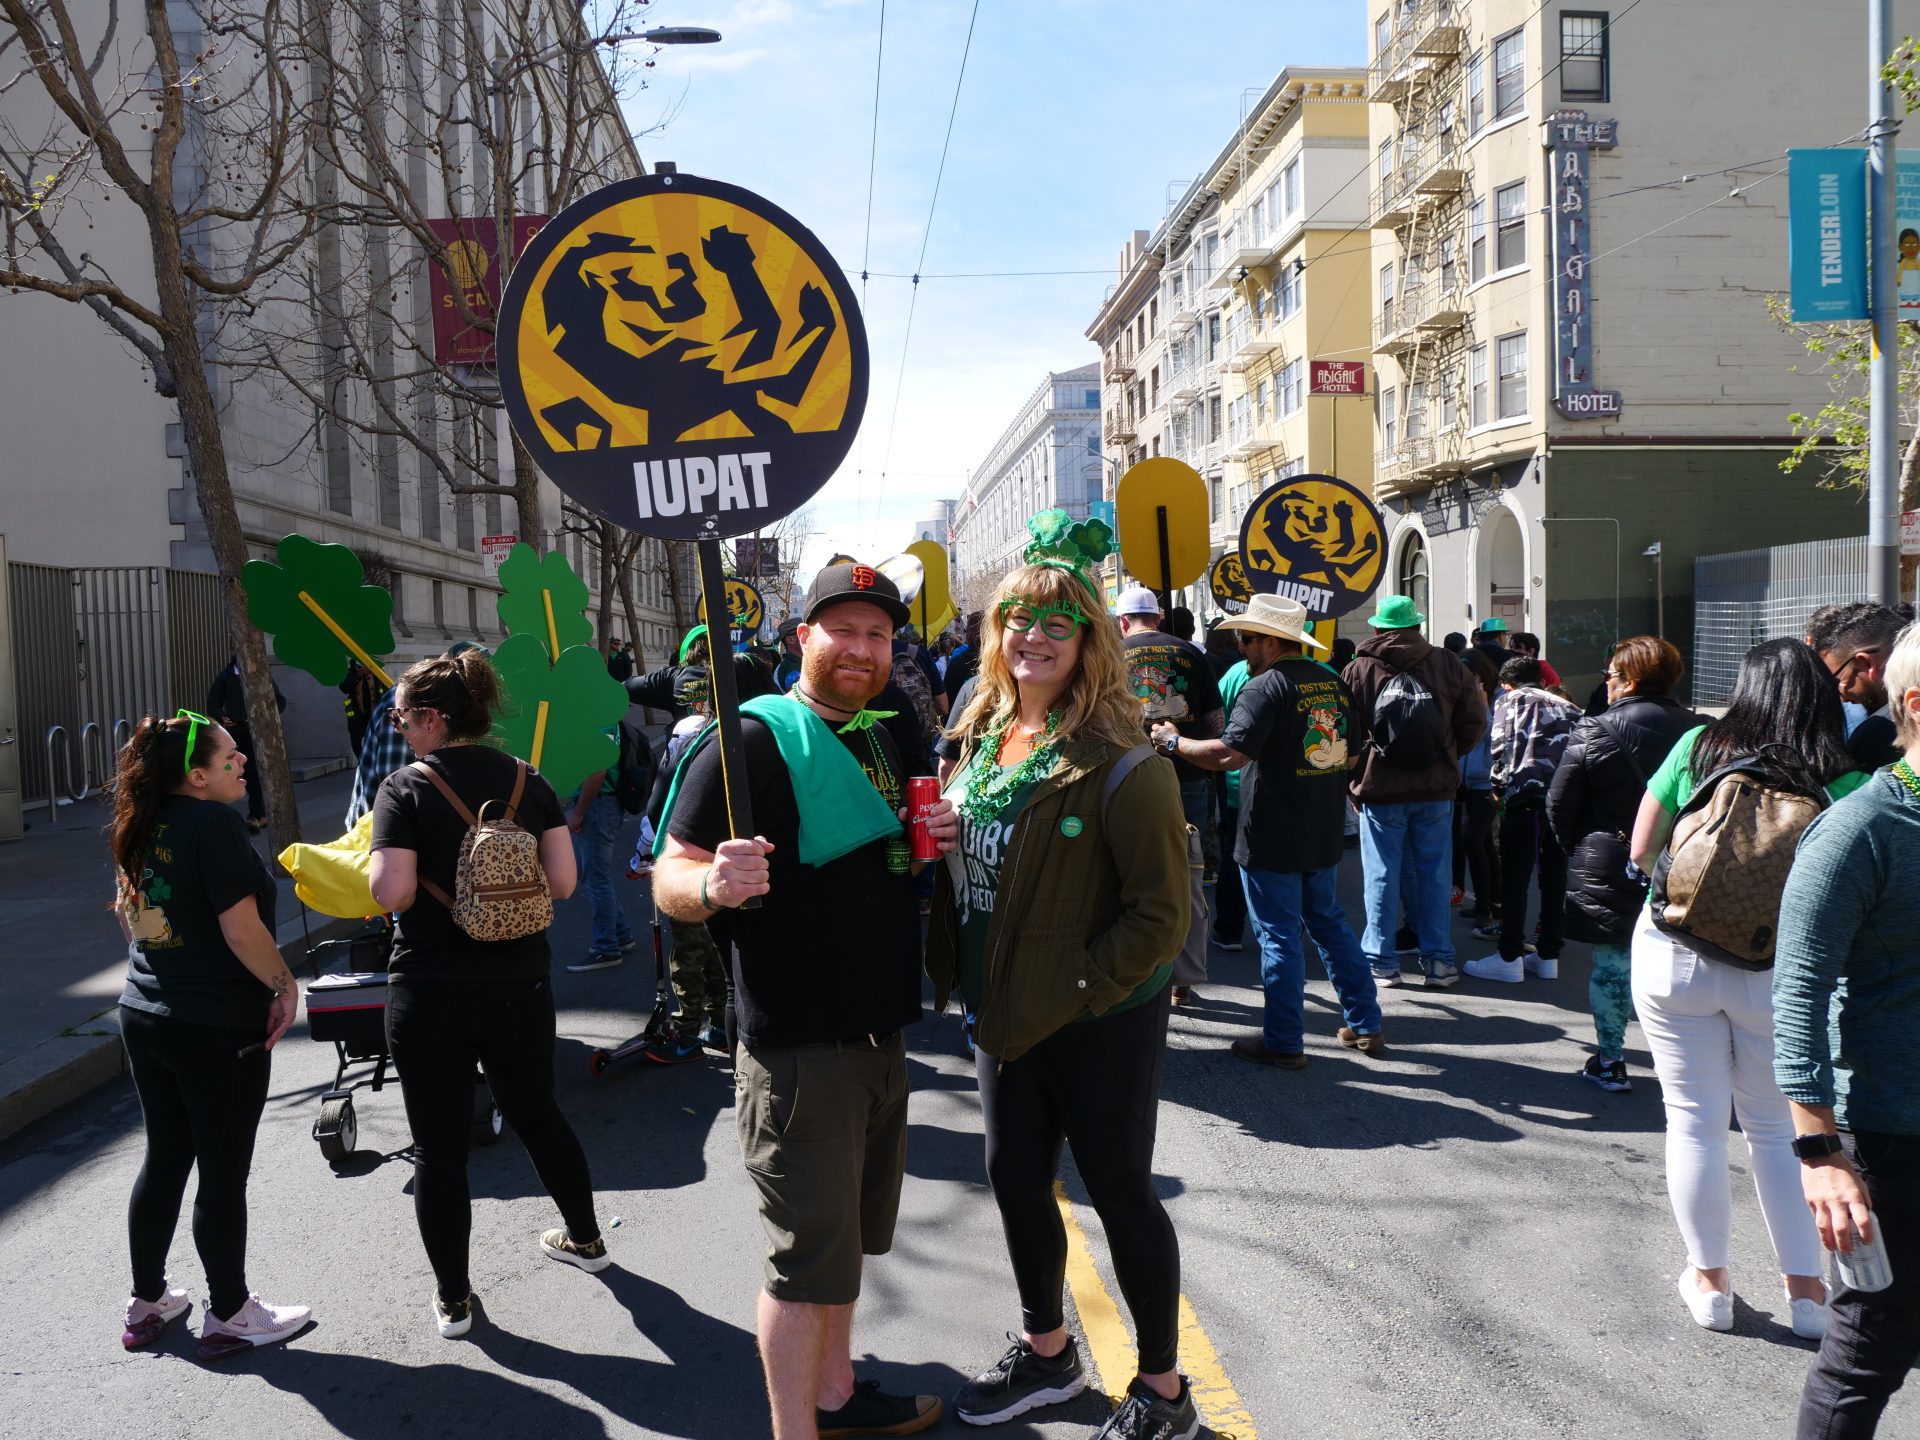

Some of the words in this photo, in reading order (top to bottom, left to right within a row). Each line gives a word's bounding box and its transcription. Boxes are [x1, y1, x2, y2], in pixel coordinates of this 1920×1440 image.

[1556, 122, 1612, 143] THE
[1818, 173, 1843, 287] TENDERLOIN
[1562, 151, 1587, 384] ABIGAIL
[443, 291, 492, 308] SCM
[1327, 362, 1345, 370] THE
[1317, 369, 1358, 384] ABIGAIL
[1322, 384, 1352, 392] HOTEL
[1567, 394, 1618, 412] HOTEL
[633, 451, 772, 518] IUPAT
[482, 544, 493, 554] NO
[1124, 645, 1179, 658] DISTRICT
[1127, 655, 1168, 667] OUNCIL
[1299, 681, 1340, 693] DISTRICT
[1297, 694, 1337, 713] COUNCIL
[966, 856, 990, 887] ON
[970, 885, 997, 913] RED
